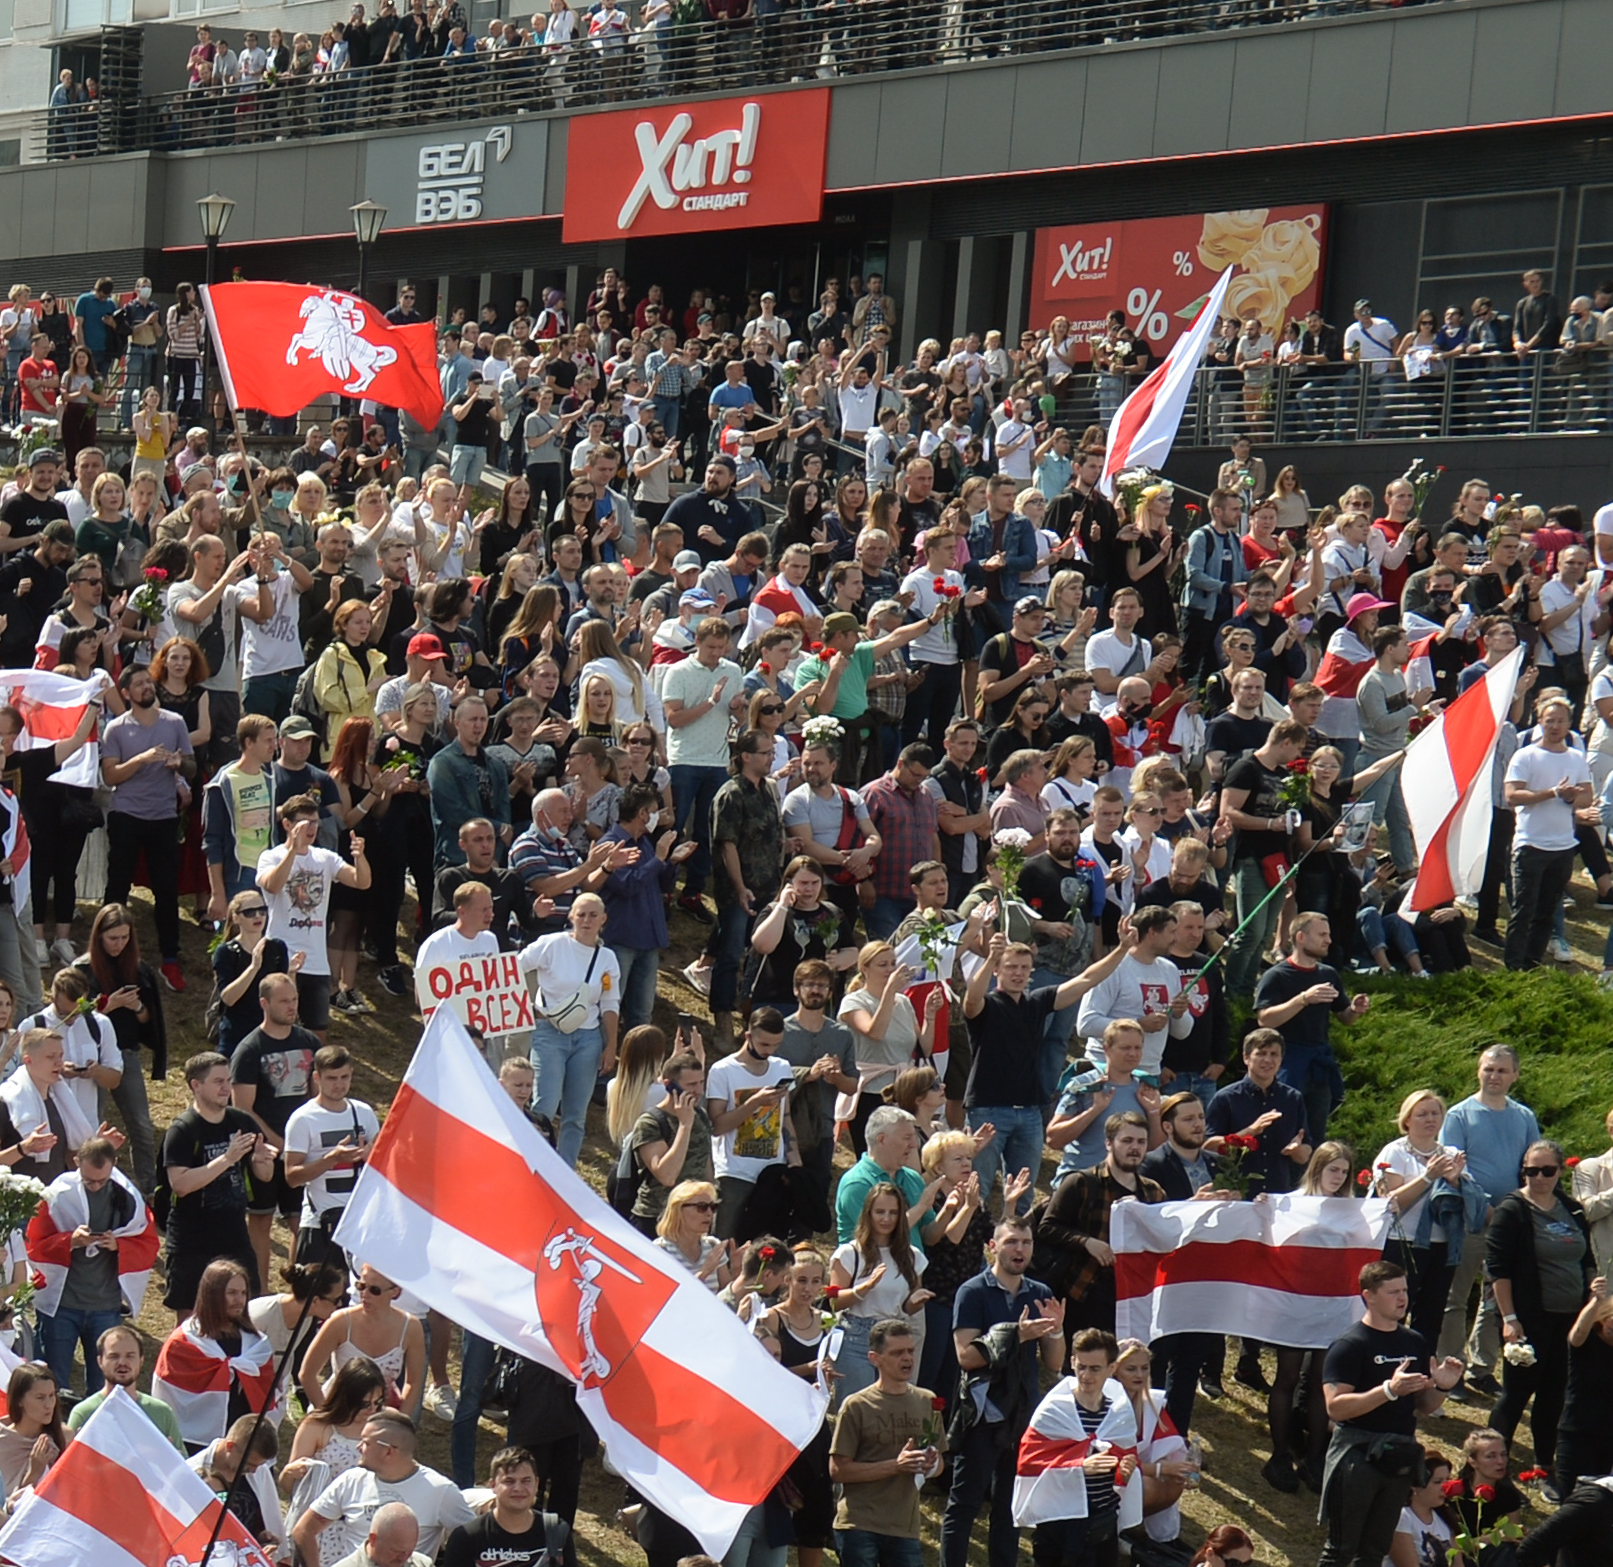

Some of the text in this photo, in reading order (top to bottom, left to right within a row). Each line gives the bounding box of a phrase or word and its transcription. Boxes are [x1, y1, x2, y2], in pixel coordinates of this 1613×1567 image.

[419, 141, 486, 179] БЕЛ
[617, 102, 760, 230] Хит!
[415, 192, 483, 223] ВЭБ
[682, 191, 749, 211] СТАНДАРТ
[1052, 246, 1112, 287] Хит!
[429, 956, 522, 999] ОДИН
[467, 990, 534, 1036] ВСЕХ
[878, 1412, 923, 1431] Make
[480, 1547, 532, 1562] athletes
